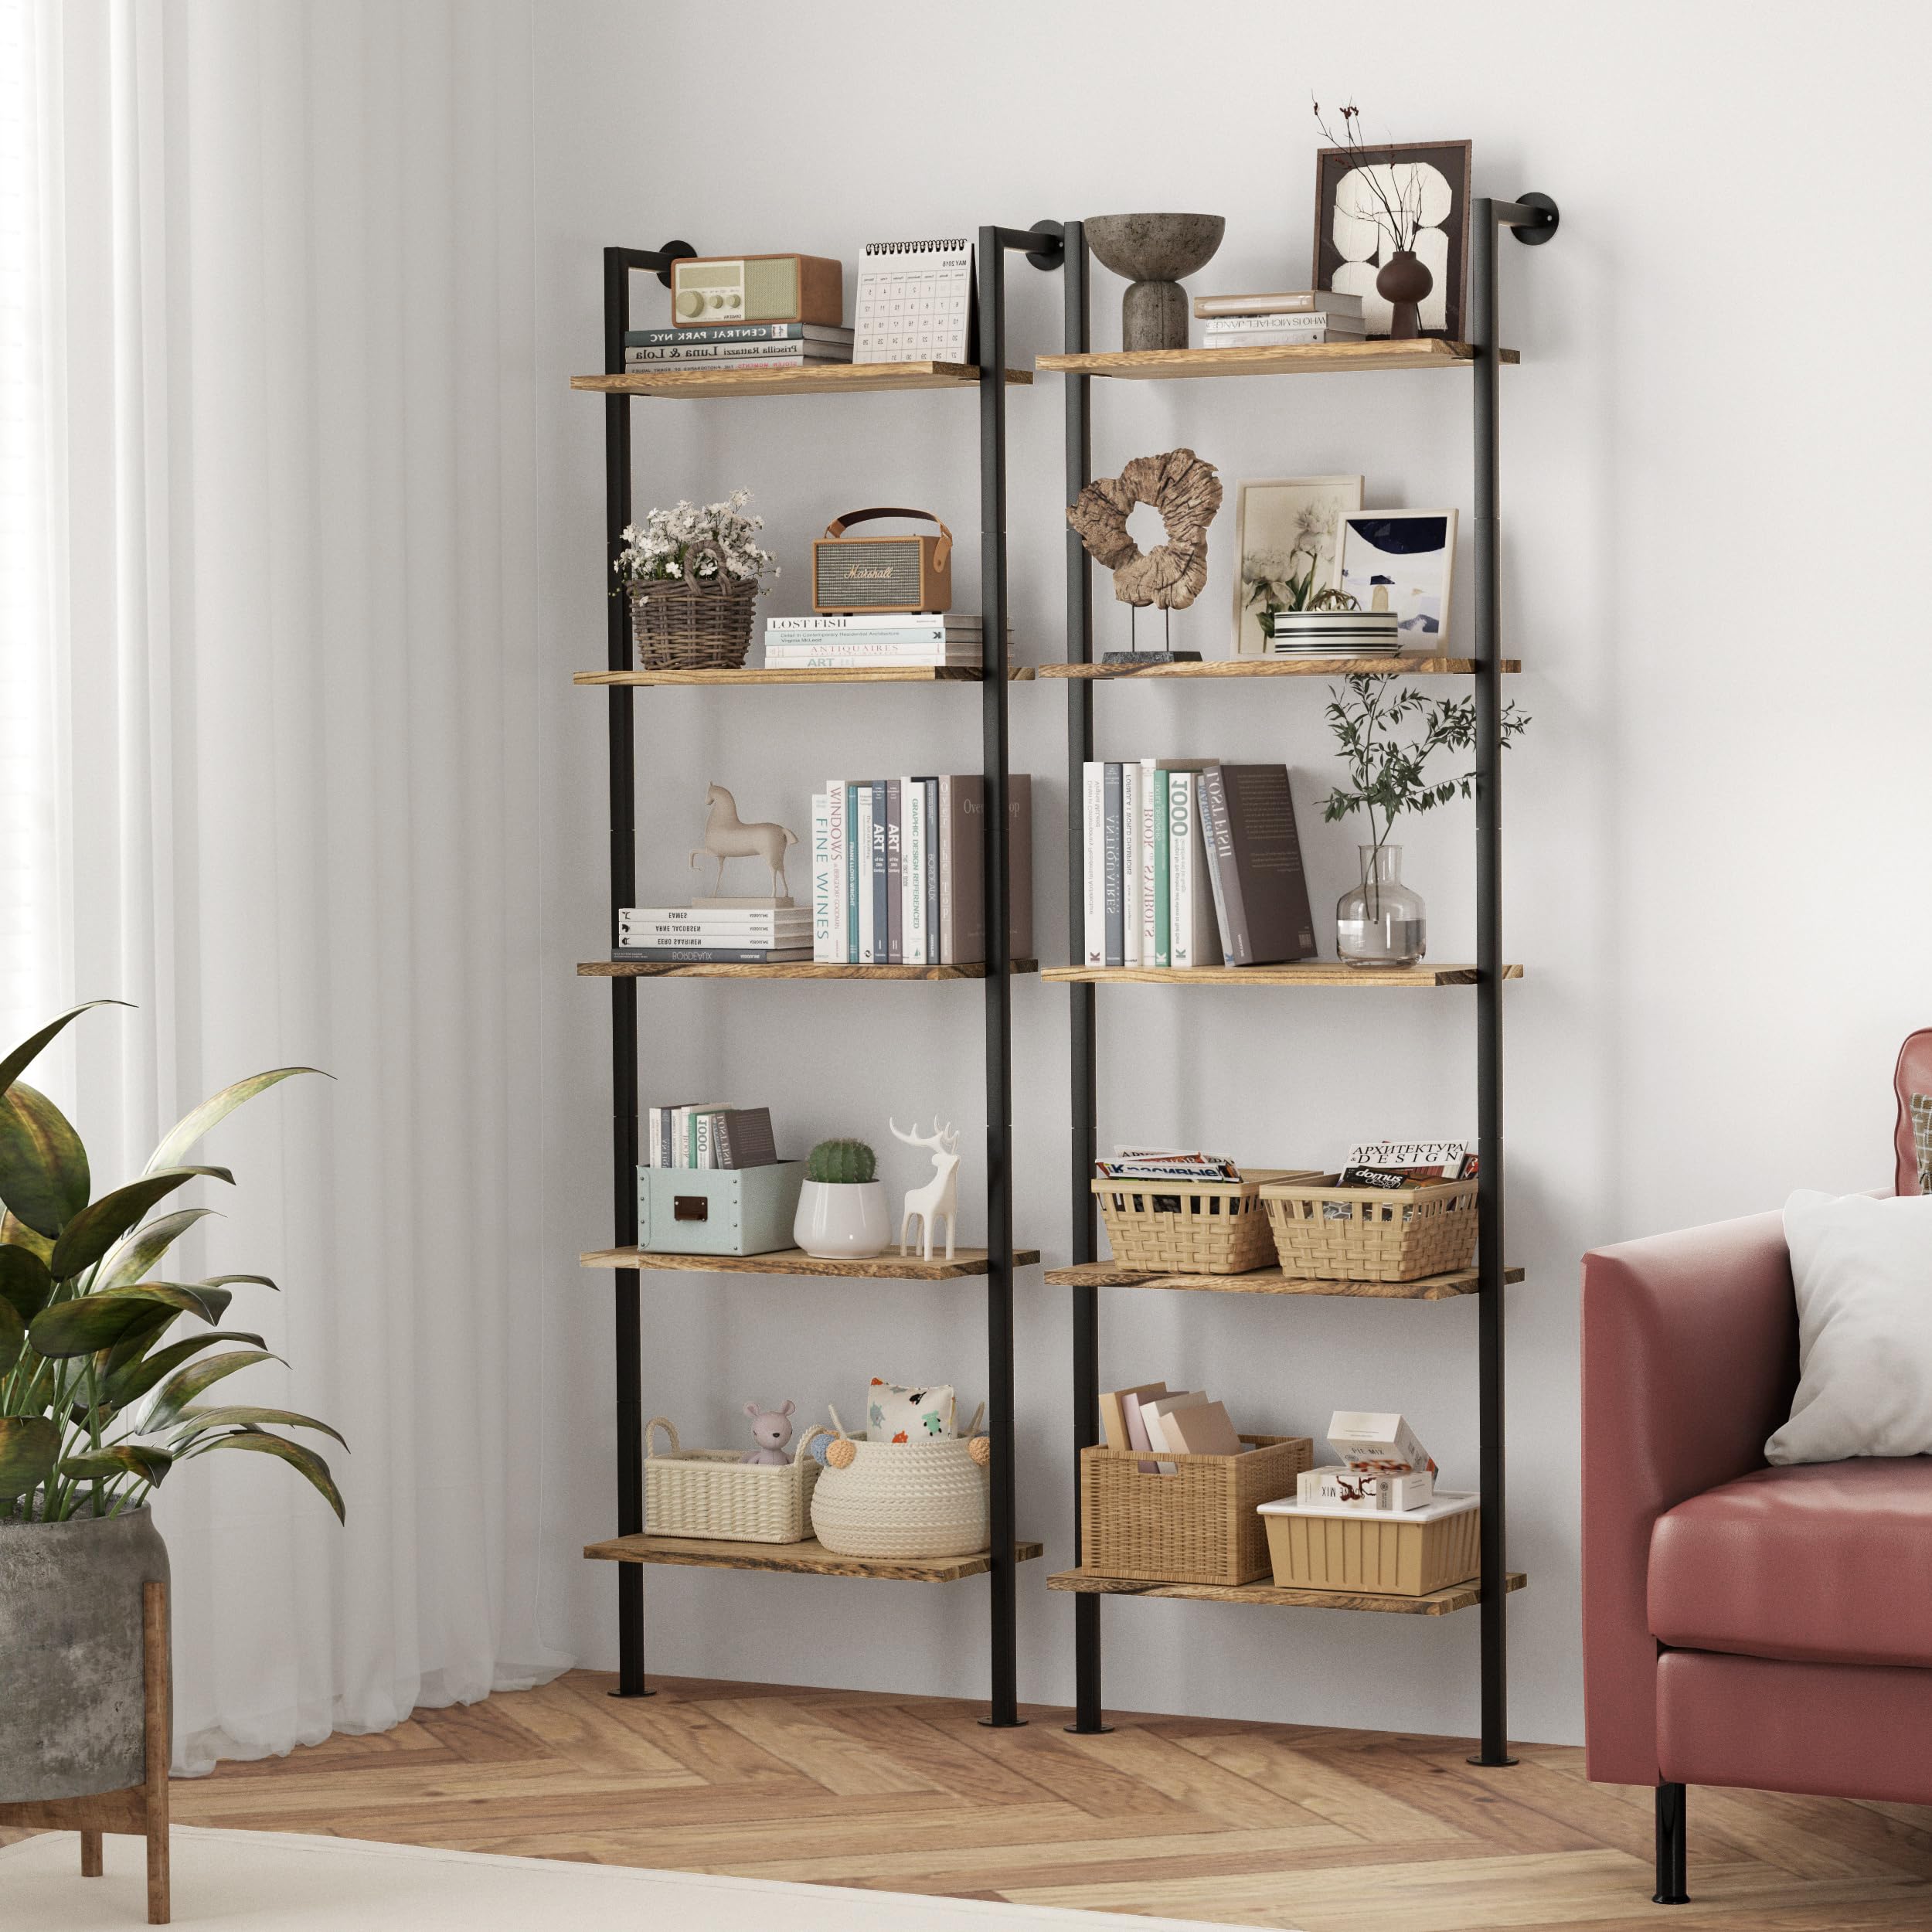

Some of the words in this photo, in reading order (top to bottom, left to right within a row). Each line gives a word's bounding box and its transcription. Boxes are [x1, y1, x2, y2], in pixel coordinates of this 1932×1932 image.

[1249, 318, 1291, 328] MICHAEL
[1303, 316, 1326, 325] WHO
[843, 564, 893, 579] Marshall
[773, 620, 811, 629] LOST
[815, 619, 847, 628] FISH
[811, 645, 899, 653] ANTIQUAIRES
[807, 658, 835, 667] ART
[830, 787, 842, 861] WINDOWS
[816, 818, 828, 862] FINE
[874, 824, 884, 852] ART
[889, 824, 900, 852] ART
[816, 872, 829, 940] WINES
[1352, 1143, 1464, 1155] АРХИТЕКТУРА
[1357, 1151, 1458, 1164] DESIGN
[1355, 1169, 1403, 1182] domus
[1366, 1175, 1401, 1189] design
[1321, 1487, 1336, 1498] MIX
